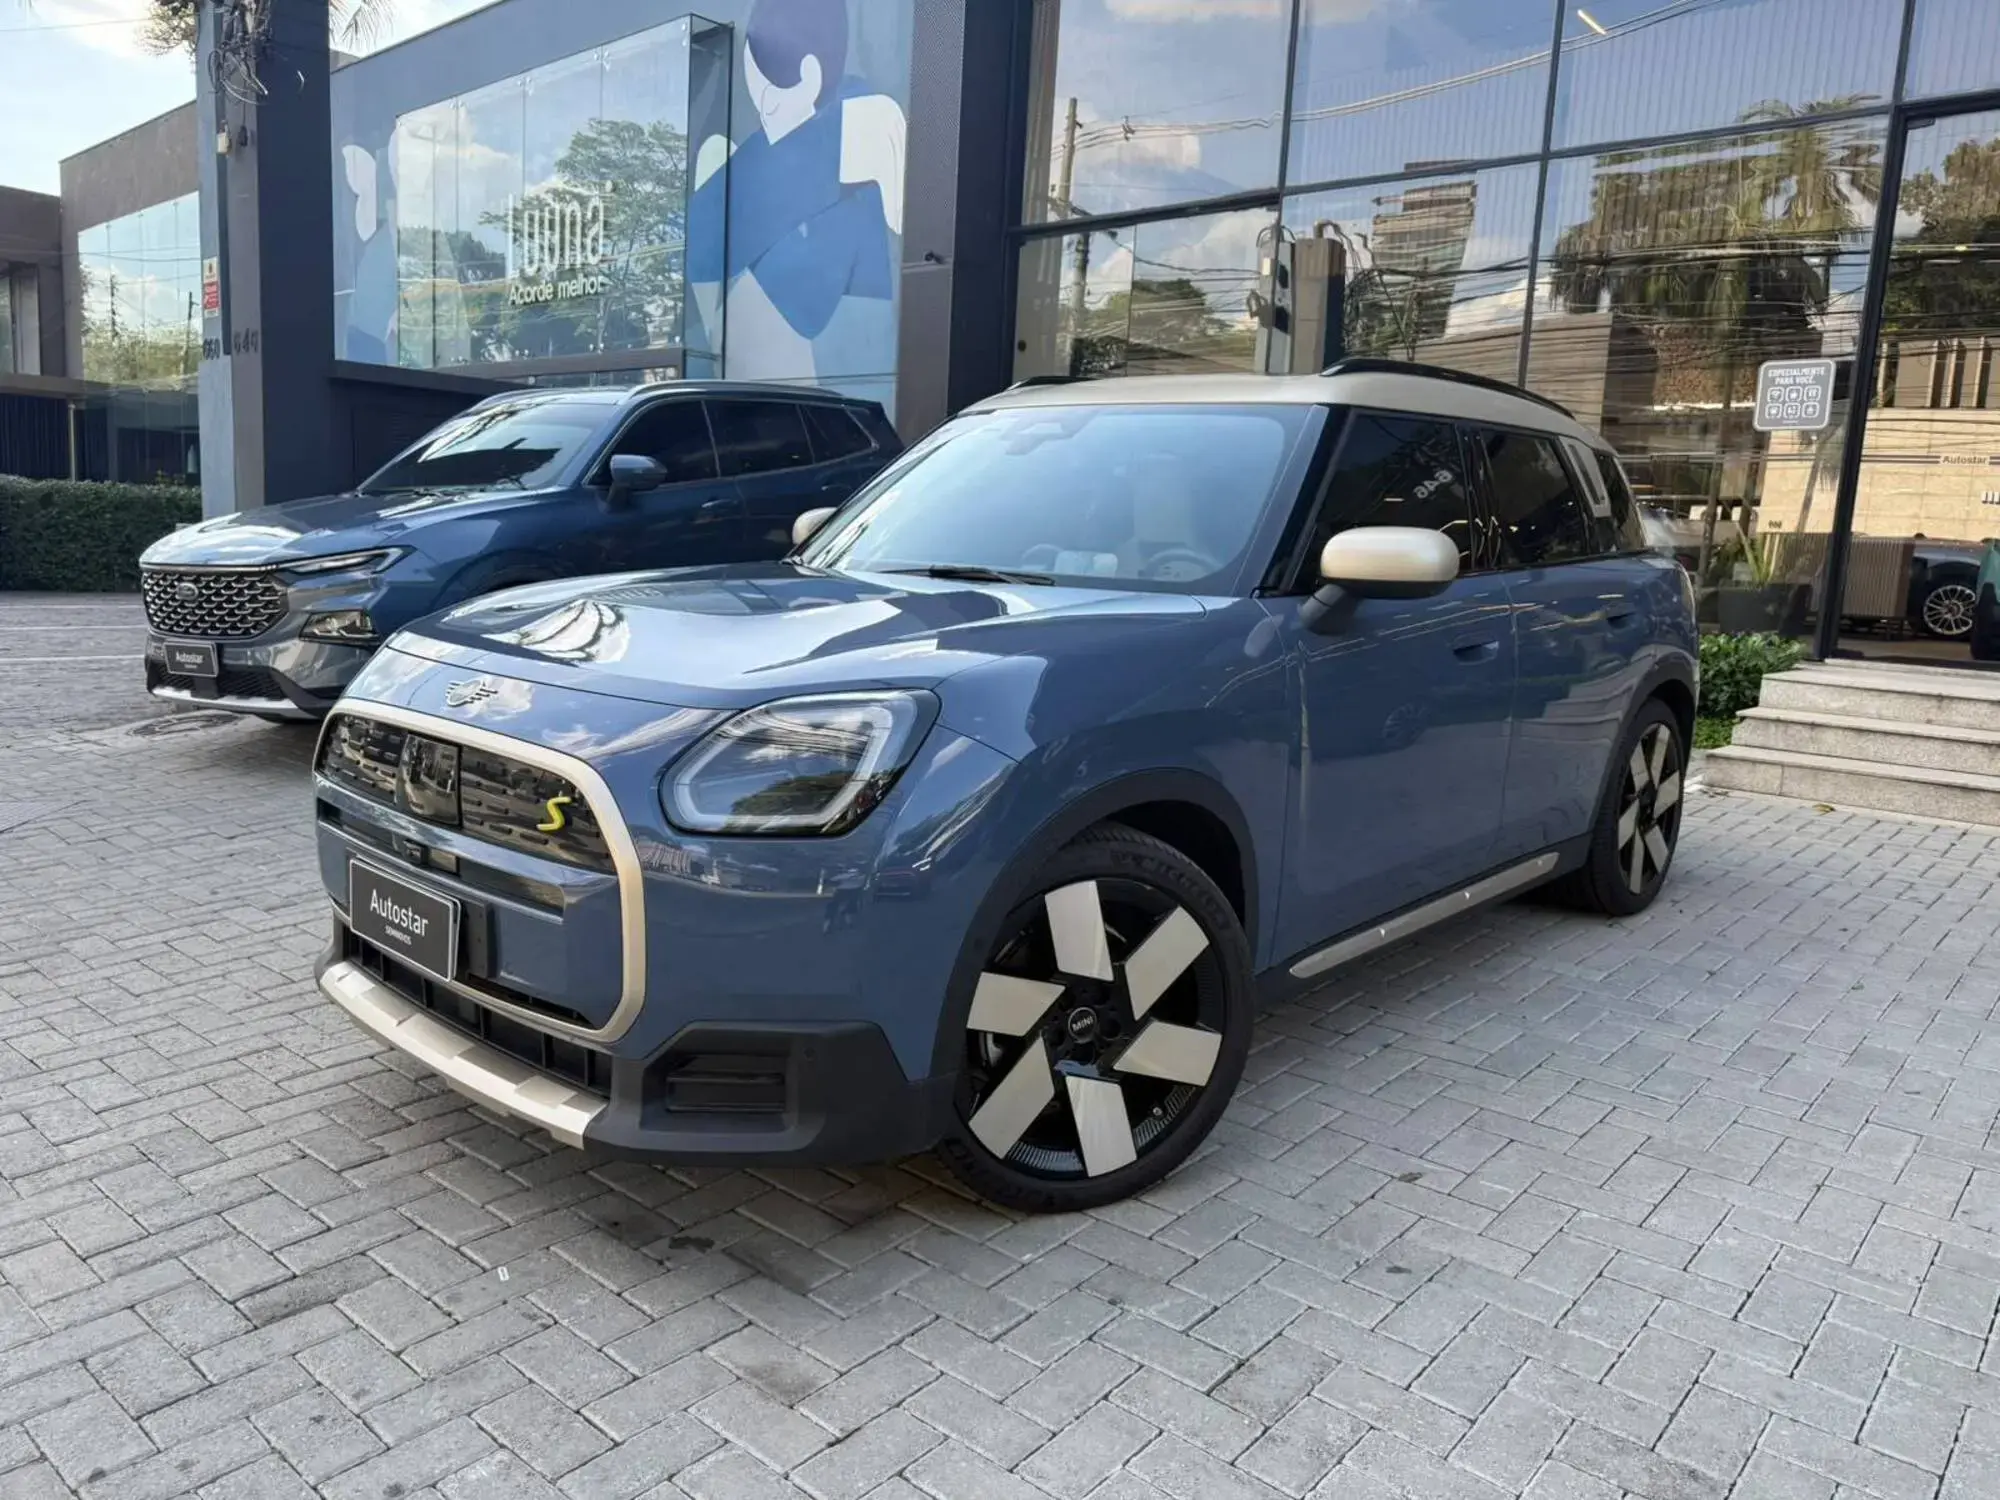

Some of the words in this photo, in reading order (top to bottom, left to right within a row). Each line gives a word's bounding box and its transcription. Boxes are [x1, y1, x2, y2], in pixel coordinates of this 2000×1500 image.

[508, 281, 554, 305] Acorde
[558, 273, 604, 299] melhor
[370, 888, 429, 937] Autostar
[1072, 1015, 1093, 1032] MINI
